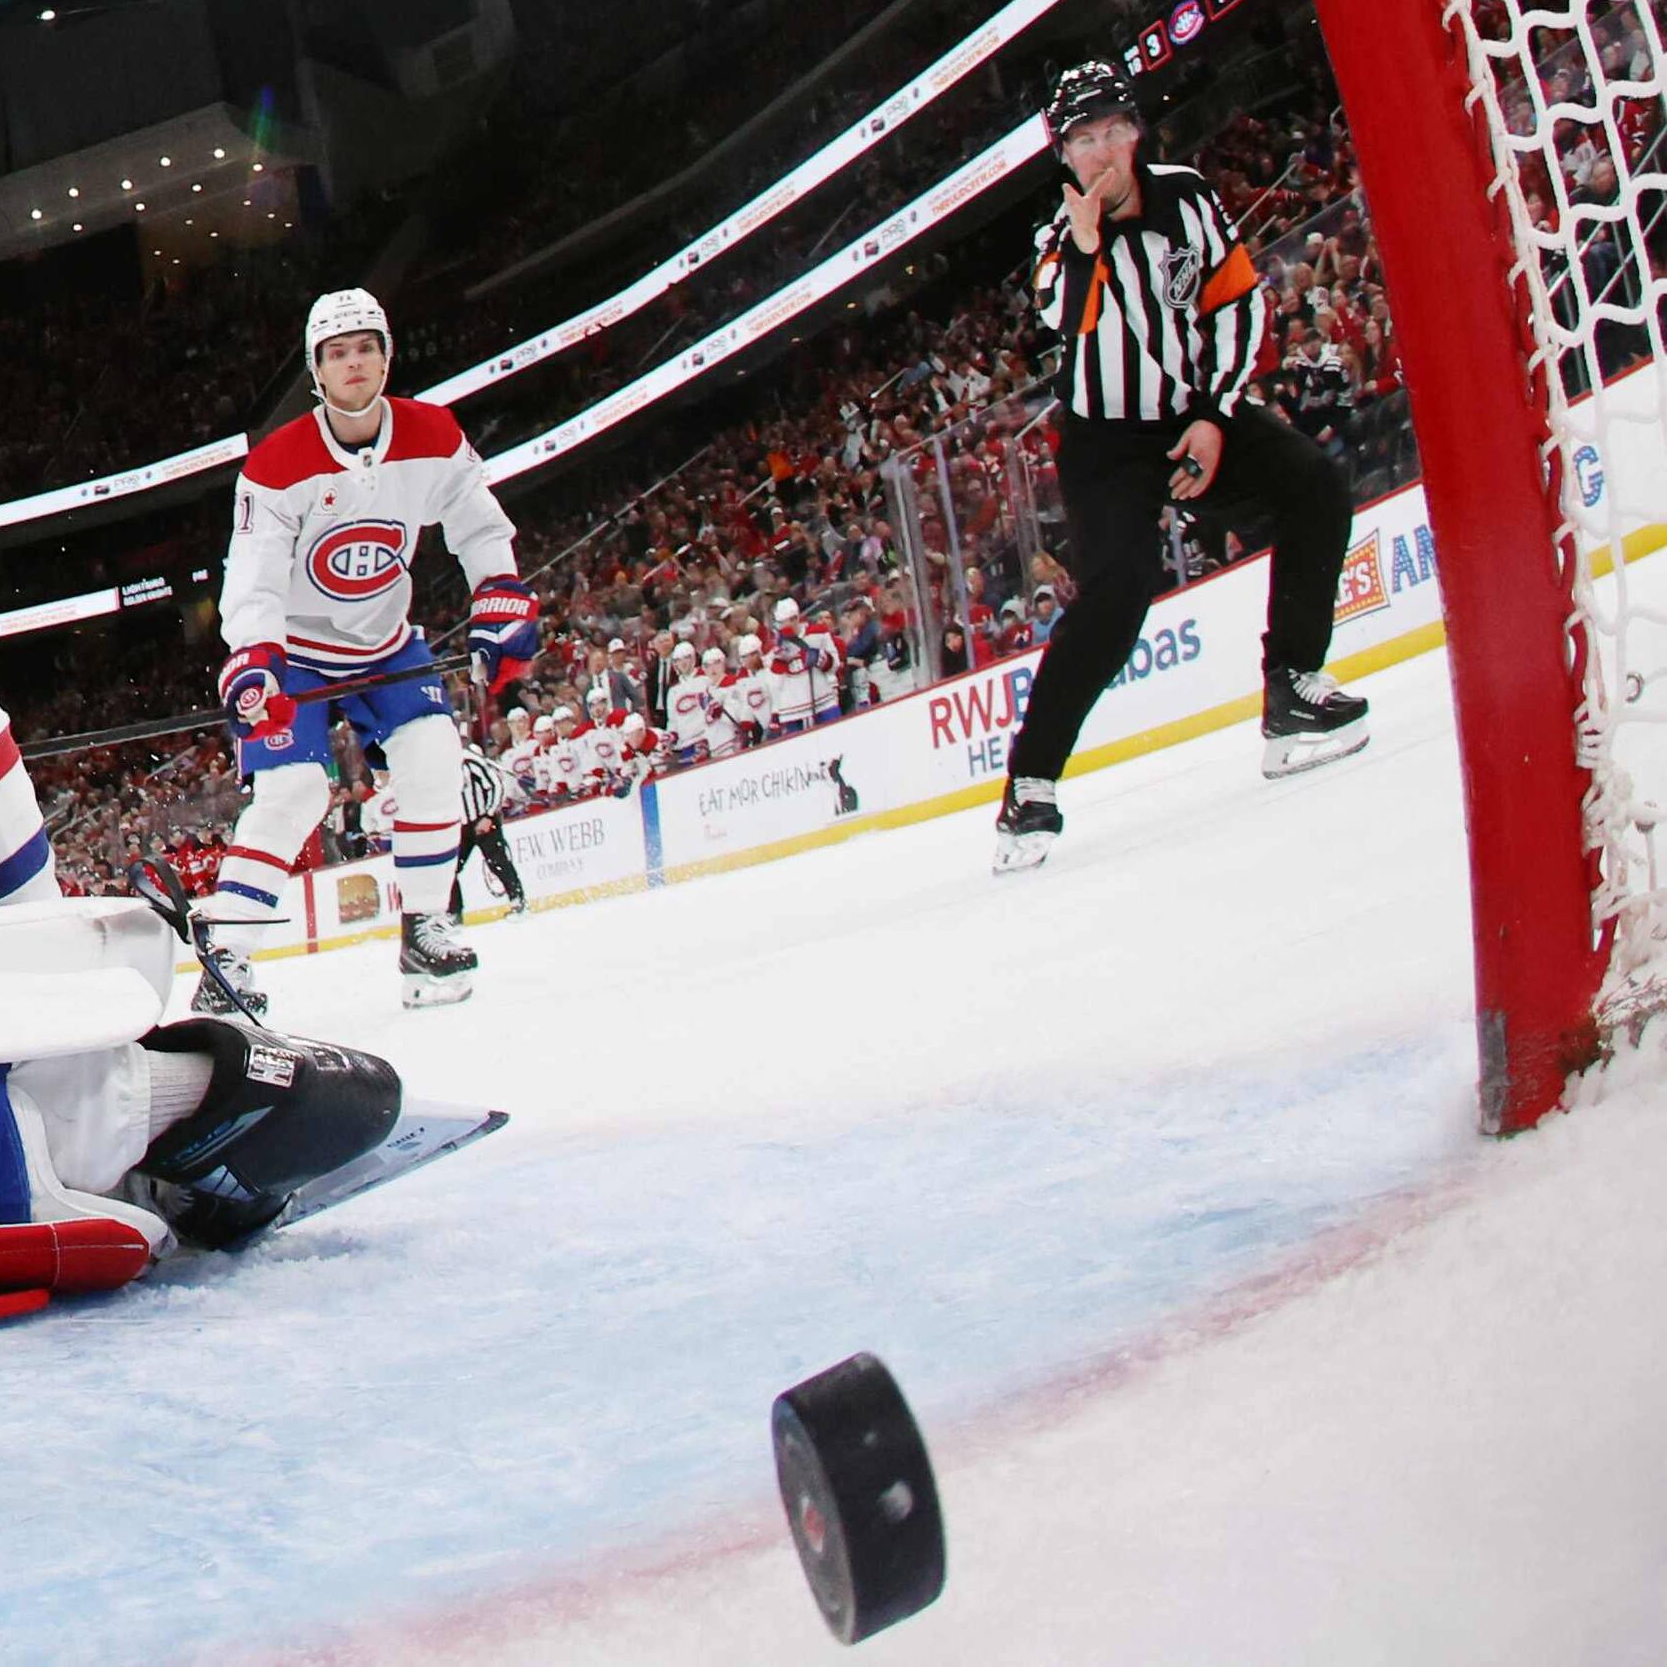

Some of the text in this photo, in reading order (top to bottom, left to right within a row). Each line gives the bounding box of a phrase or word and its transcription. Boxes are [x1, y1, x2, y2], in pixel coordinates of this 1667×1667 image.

[1146, 34, 1161, 57] 3
[698, 766, 810, 817] EAT MOR CHIKIN
[549, 818, 605, 855] WEBB
